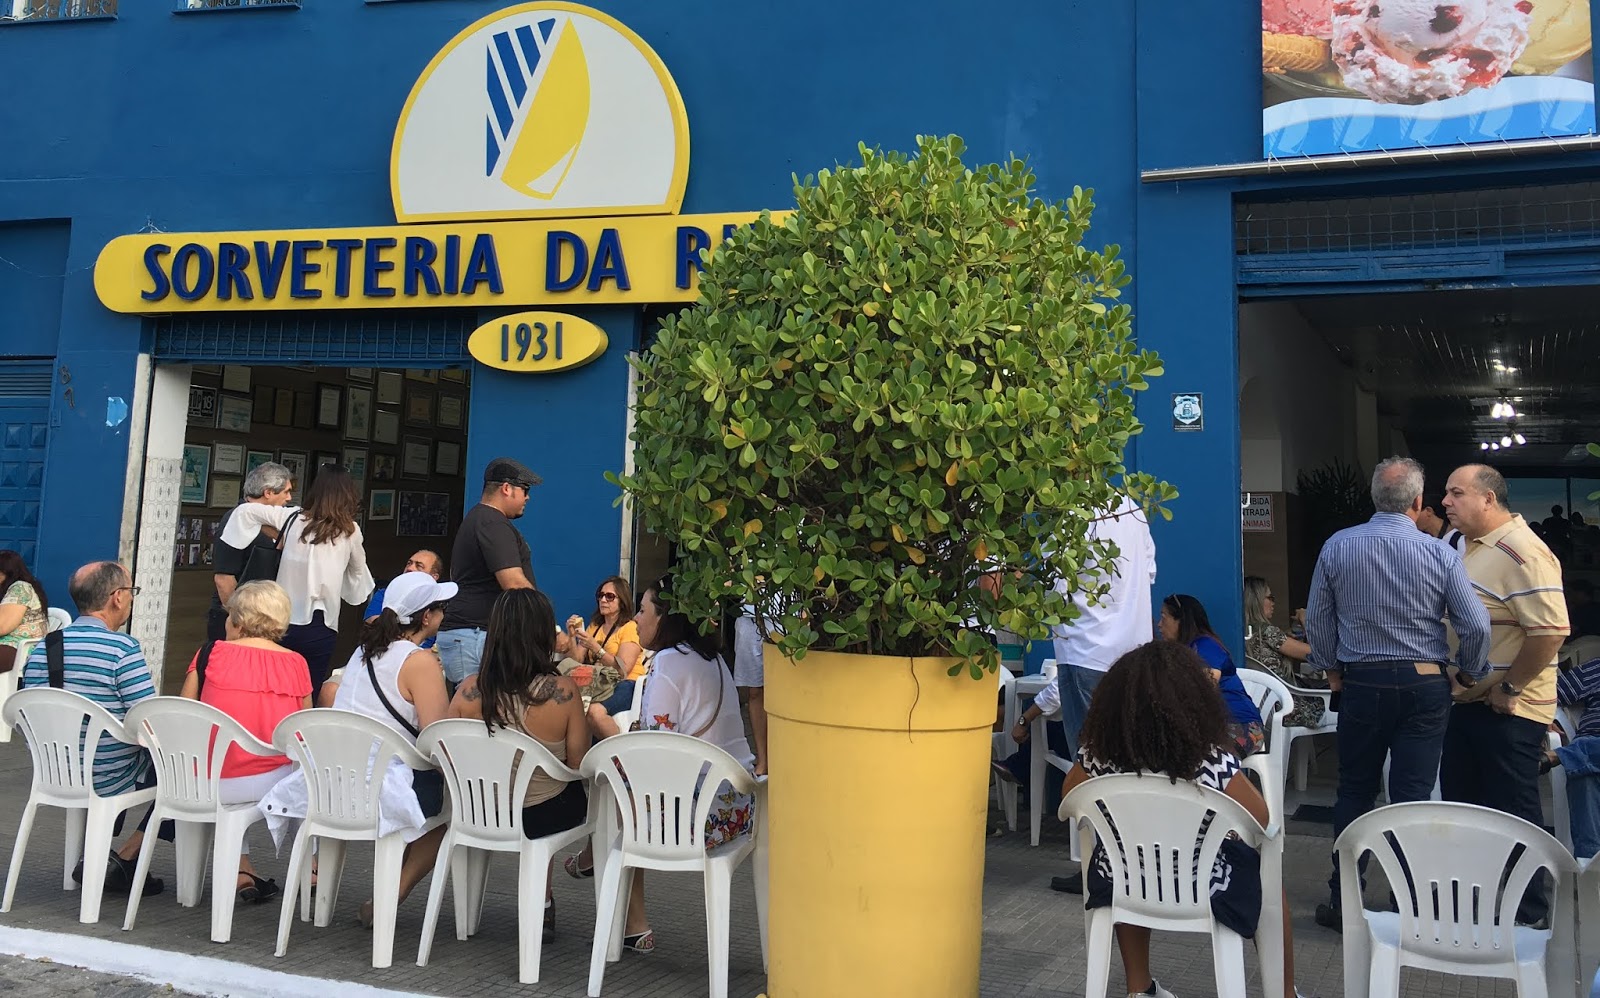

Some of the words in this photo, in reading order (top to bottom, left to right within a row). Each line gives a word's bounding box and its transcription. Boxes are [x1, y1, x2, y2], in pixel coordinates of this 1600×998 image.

[141, 234, 504, 302] SORVETERIA
[545, 228, 631, 292] DA
[501, 321, 563, 361] 1931
